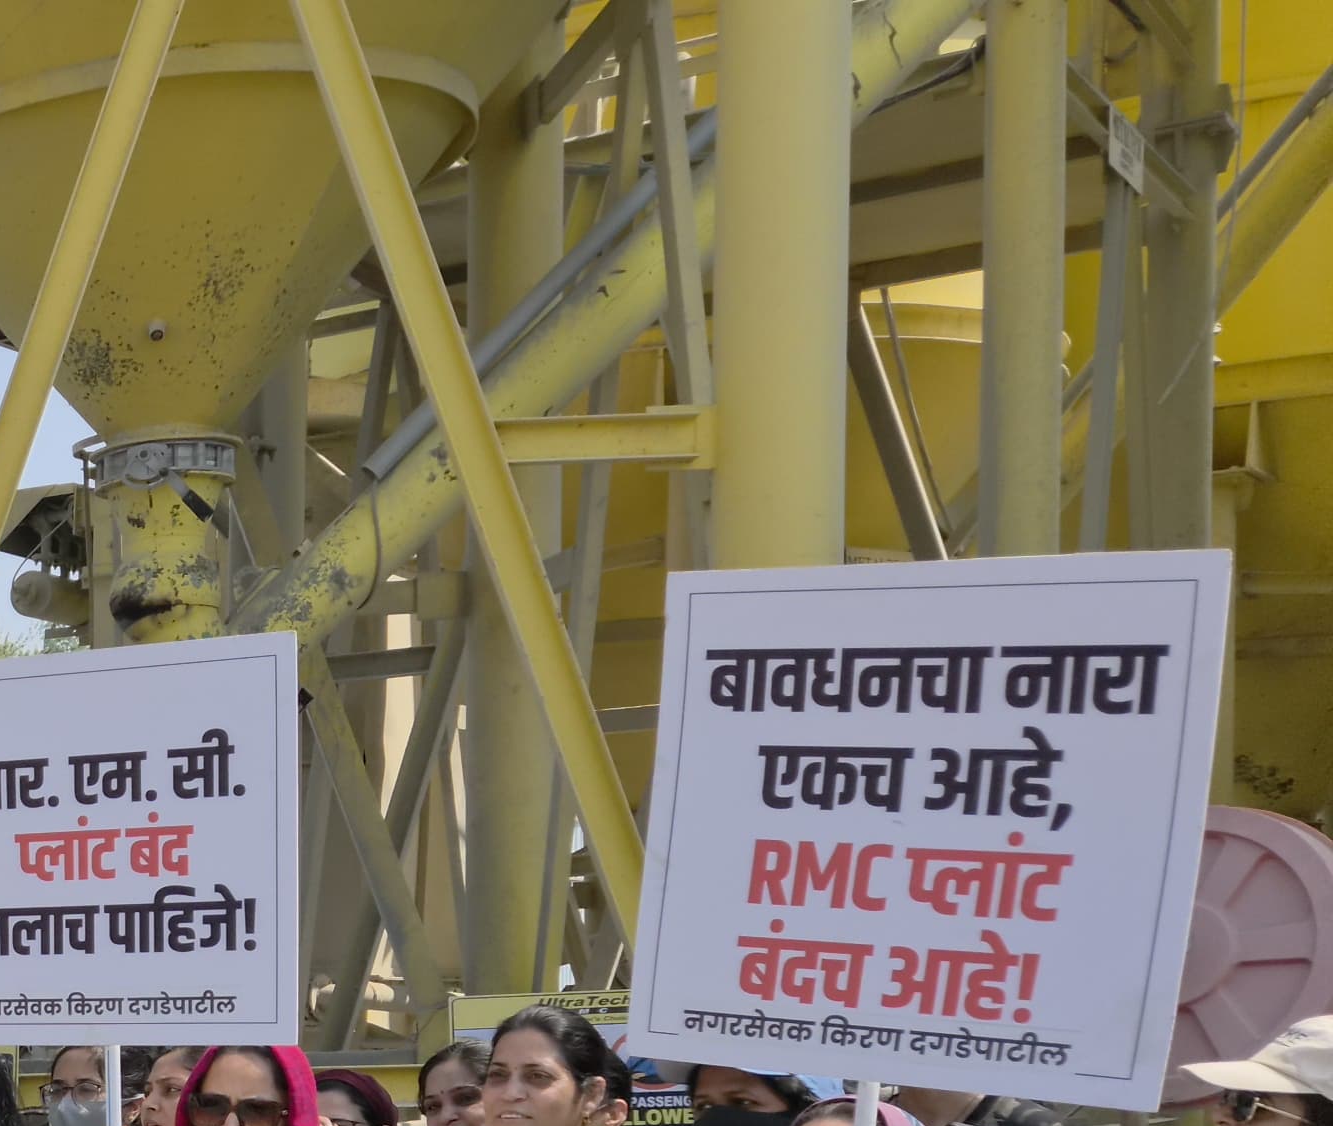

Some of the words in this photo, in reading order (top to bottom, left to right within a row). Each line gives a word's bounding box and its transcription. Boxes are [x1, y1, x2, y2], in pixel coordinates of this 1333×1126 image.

[705, 646, 994, 714] बावधनचा
[1000, 644, 1170, 715] नारा
[68, 750, 158, 806] एम.
[166, 728, 246, 800] सी.
[757, 744, 915, 813] एकच
[923, 725, 1073, 832] आहे,
[14, 815, 122, 882] प्लांट
[124, 811, 194, 878] बंद
[746, 838, 894, 912] RMC
[904, 831, 1074, 922] प्लांट
[103, 883, 257, 954] पाहिजे!
[65, 991, 125, 1016] किरण
[126, 989, 238, 1016] दगडेपाटील
[736, 918, 875, 1009] बंदच
[880, 929, 1041, 1024] आहे!
[683, 1008, 817, 1043] नगरसेवक
[820, 1014, 905, 1052] किरण
[908, 1026, 1072, 1066] दगडेपाटील
[630, 1096, 692, 1107] PASSENG
